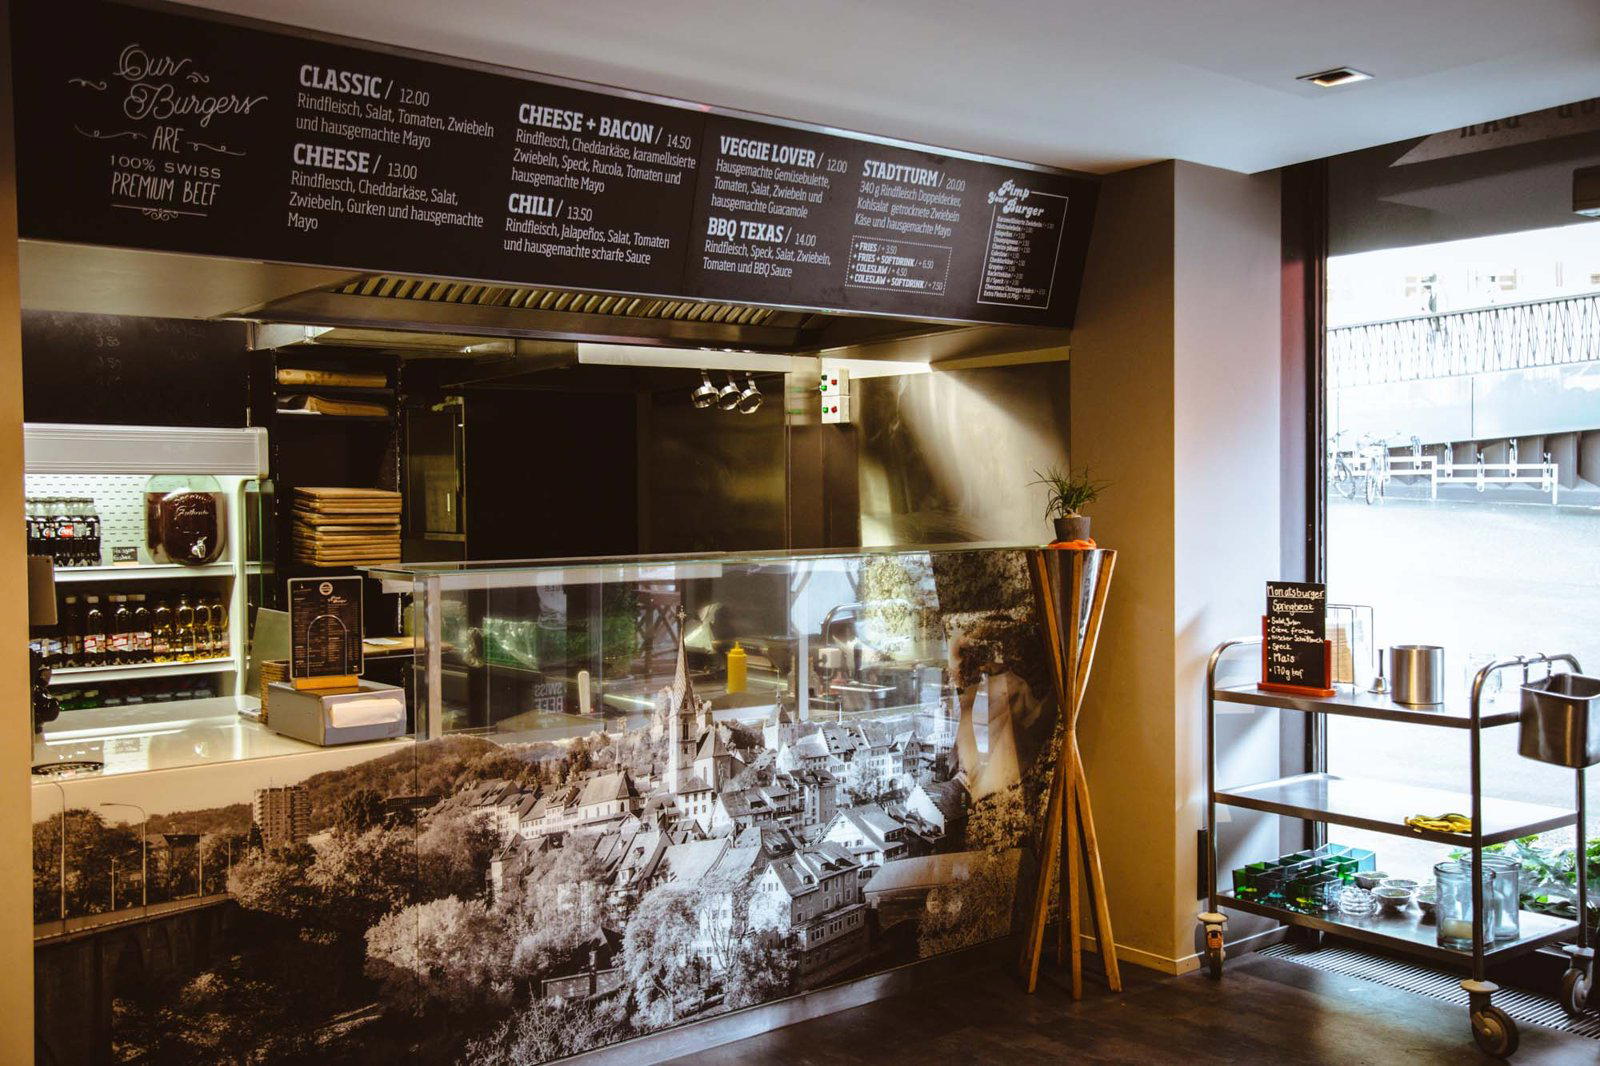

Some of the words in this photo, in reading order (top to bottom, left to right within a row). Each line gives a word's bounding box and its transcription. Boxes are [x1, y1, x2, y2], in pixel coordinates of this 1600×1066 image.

[113, 44, 192, 81] Our
[300, 65, 382, 98] CLASSIC
[400, 88, 430, 107] 12.00
[123, 83, 268, 127] Burgers
[298, 93, 362, 118] Rindfleisch,
[366, 104, 394, 124] Salat,
[399, 109, 445, 130] Tomaten,
[448, 117, 494, 137] Zwiebeln
[152, 126, 184, 153] ARE
[296, 117, 317, 132] und
[321, 118, 400, 144] hausgemachte
[403, 131, 431, 150] Mayo
[519, 103, 583, 132] CHEESE
[599, 117, 654, 143] BACON
[667, 134, 691, 150] 14.50
[293, 143, 369, 173] CHEESE
[388, 163, 417, 180] 13.00
[516, 129, 570, 151] Rindfleisch,
[573, 138, 630, 160] Cheddarkäse,
[633, 148, 696, 169] karamellisierte
[720, 136, 770, 161] VEGGIE
[771, 144, 816, 168] LOVER
[827, 159, 847, 173] 12.00
[111, 155, 155, 172] 100%
[164, 162, 221, 179] SWISS
[514, 148, 559, 168] Zwiebeln,
[562, 155, 590, 173] Speck,
[593, 160, 623, 177] Rucola,
[627, 164, 663, 182] Tomaten
[665, 172, 681, 185] und
[716, 159, 773, 179] Hausgemachte
[774, 168, 830, 189] Gemüsebulette,
[863, 160, 938, 187] STADTTURM
[111, 172, 174, 201] PREMIUM
[183, 180, 220, 206] BEEF
[291, 170, 355, 193] Rindfleisch,
[359, 179, 428, 202] Cheddarkäse,
[431, 188, 458, 206] Salat,
[512, 167, 579, 190] hausgemachte
[581, 177, 605, 194] Mayo
[714, 176, 749, 194] Tomaten,
[751, 182, 771, 197] Salat,
[773, 185, 806, 201] Zwiebeln
[808, 192, 823, 203] und
[859, 181, 874, 193] 340
[880, 184, 917, 200] Rindfleisch
[998, 180, 1030, 200] Pimp
[289, 192, 344, 213] Zwiebeln,
[347, 199, 385, 217] Gurken
[389, 206, 408, 219] und
[411, 207, 484, 228] hausgemachte
[508, 193, 554, 216] CHILI
[567, 206, 593, 222] 13.50
[711, 194, 766, 213] hausgemachte
[768, 201, 808, 218] Guacamole
[1003, 198, 1044, 218] Burger
[288, 212, 318, 231] Mayo
[506, 218, 559, 237] Rindfleisch,
[561, 225, 605, 243] Jalapeños,
[608, 230, 631, 246] Salat,
[634, 233, 670, 248] Tomaten
[707, 217, 736, 241] BBQ
[740, 222, 784, 242] TEXAS
[795, 233, 816, 246] 14.00
[855, 213, 871, 225] Käse
[872, 217, 885, 228] und
[886, 217, 933, 233] hausgemachte
[934, 225, 951, 238] Mayo
[504, 239, 522, 251] und
[524, 239, 590, 258] hausgemachte
[592, 247, 624, 262] scharfe
[626, 250, 651, 264] Sauce
[797, 251, 831, 265] Zwiebeln,
[858, 253, 875, 262] FRIES
[860, 242, 877, 252] FRIES
[703, 257, 736, 272] Tomaten
[738, 262, 752, 273] und
[754, 262, 770, 277] BBQ
[771, 265, 792, 277] Sauce
[854, 274, 885, 285] COLESLAW
[856, 263, 887, 274] COLESLAW
[1267, 586, 1324, 600] Monatsburger
[1274, 653, 1295, 662] Mais
